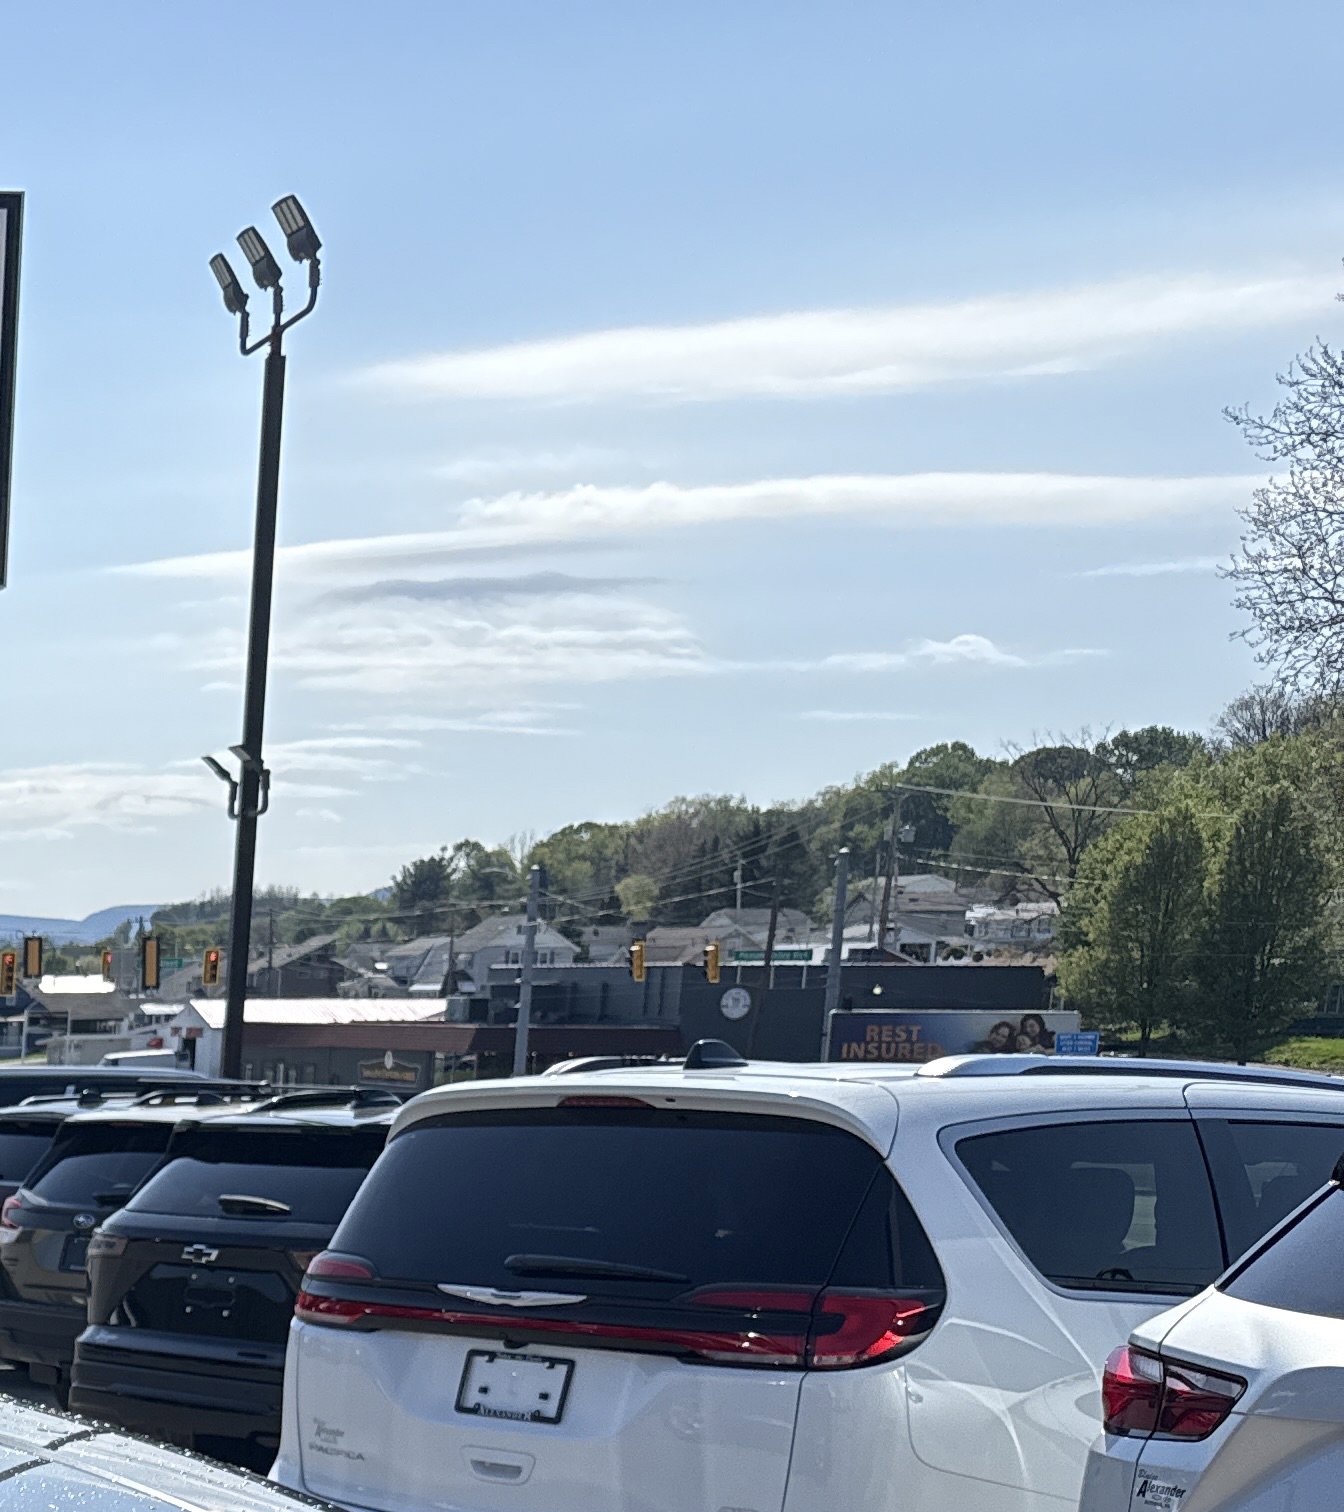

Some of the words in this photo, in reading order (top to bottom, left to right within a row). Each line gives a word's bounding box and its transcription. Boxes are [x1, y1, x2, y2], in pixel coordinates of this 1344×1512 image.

[865, 1024, 922, 1042] REST
[841, 1042, 945, 1060] INSURED
[1135, 1479, 1187, 1499] Alexander
